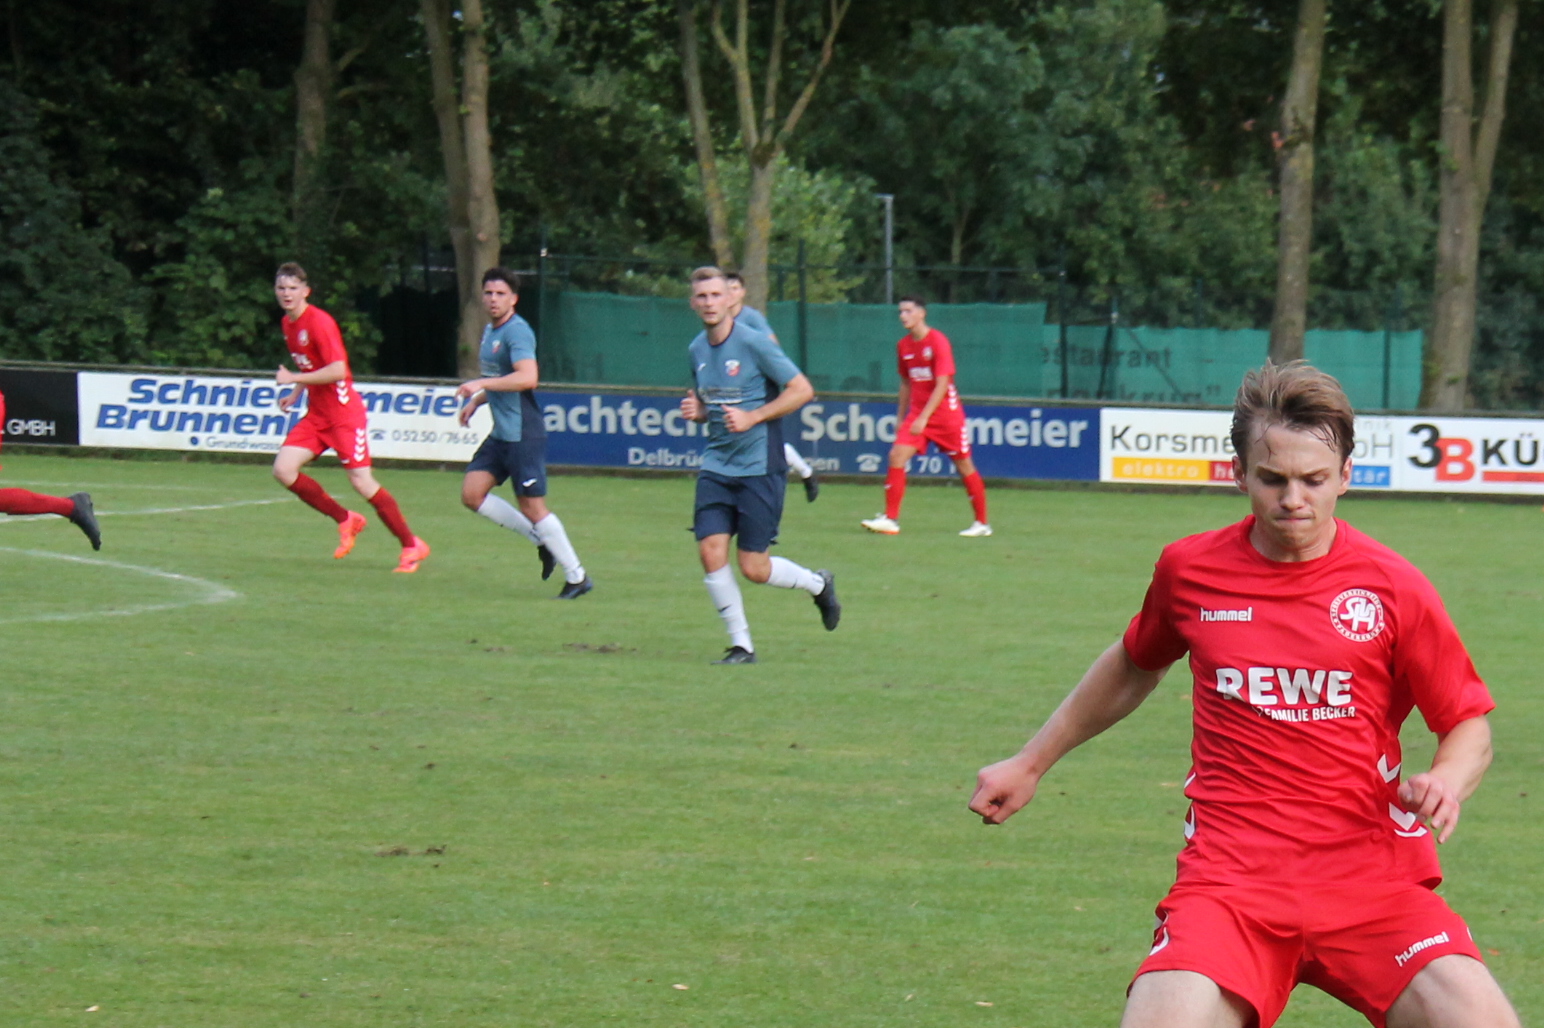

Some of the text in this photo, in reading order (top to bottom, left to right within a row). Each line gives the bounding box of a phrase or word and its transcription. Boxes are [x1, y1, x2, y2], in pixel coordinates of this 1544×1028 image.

[628, 447, 703, 467] Delbrü
[1408, 423, 1476, 482] 3B
[1200, 606, 1253, 622] hummel
[1215, 666, 1354, 707] REWE
[1312, 706, 1356, 720] BECKER
[1394, 931, 1450, 967] hummel
